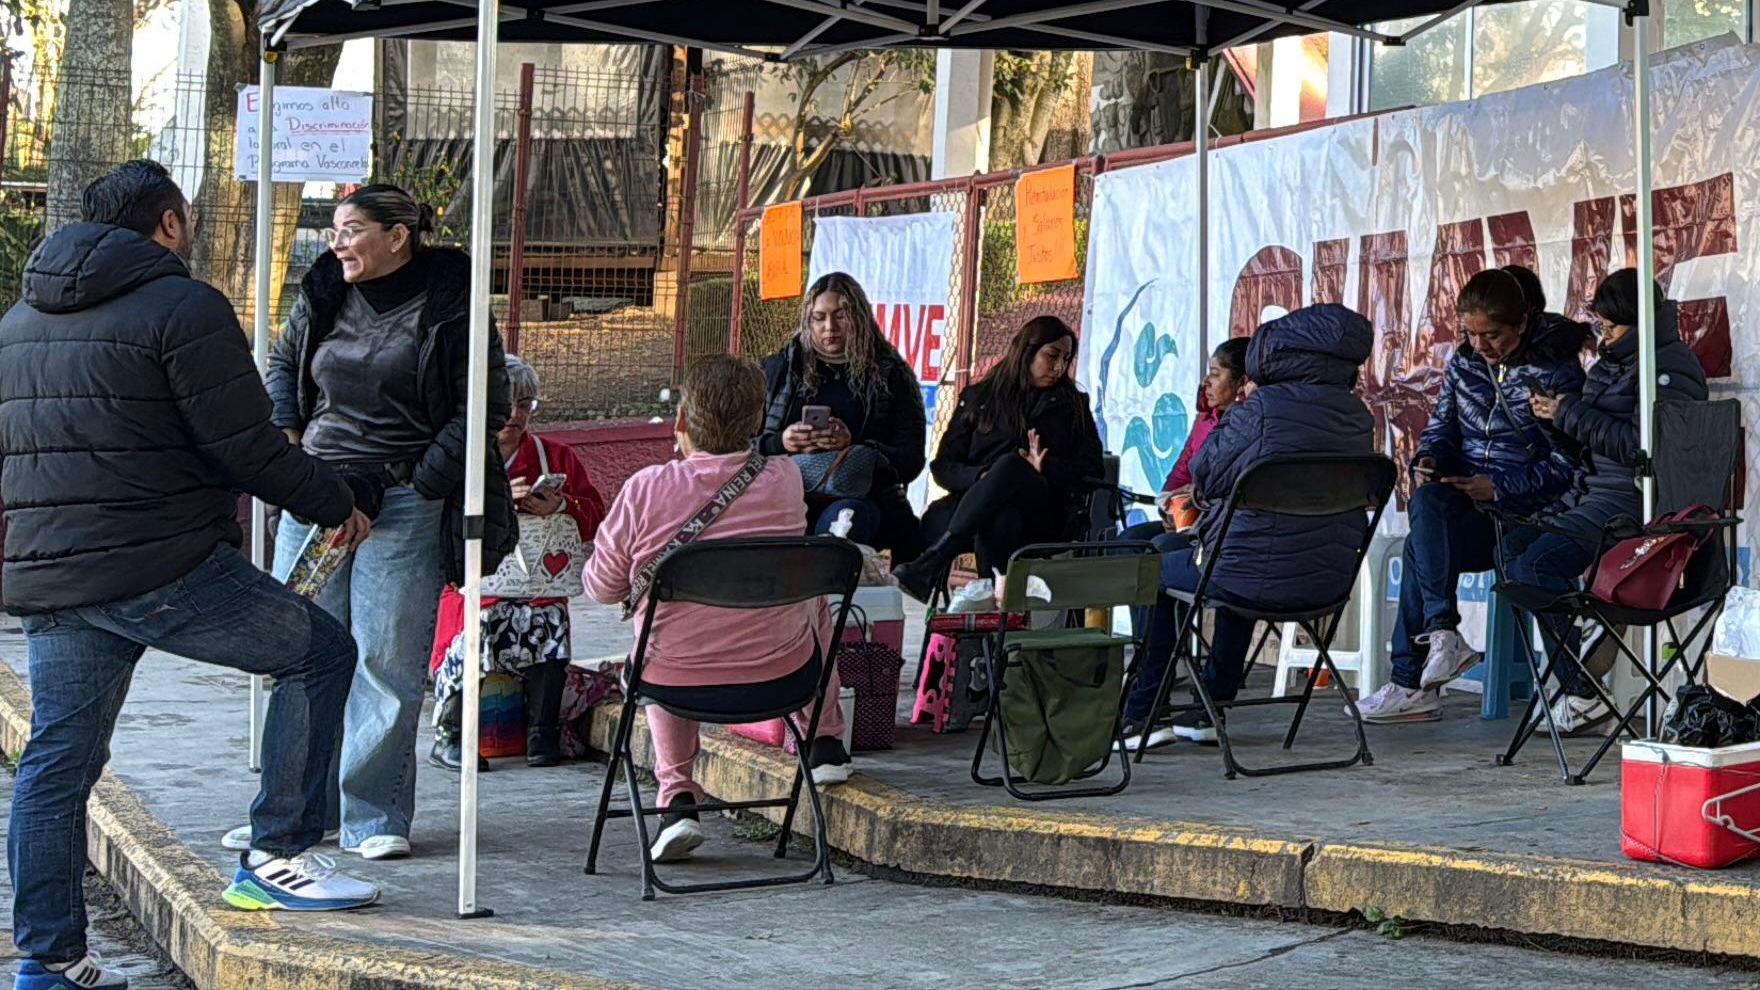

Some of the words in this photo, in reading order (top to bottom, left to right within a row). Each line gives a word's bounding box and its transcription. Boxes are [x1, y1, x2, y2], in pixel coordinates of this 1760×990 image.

[246, 92, 313, 116] Egimos
[322, 96, 350, 110] alto
[286, 116, 369, 131] Discriminación
[301, 141, 322, 152] en
[329, 139, 346, 152] el
[713, 471, 752, 508] REINA
